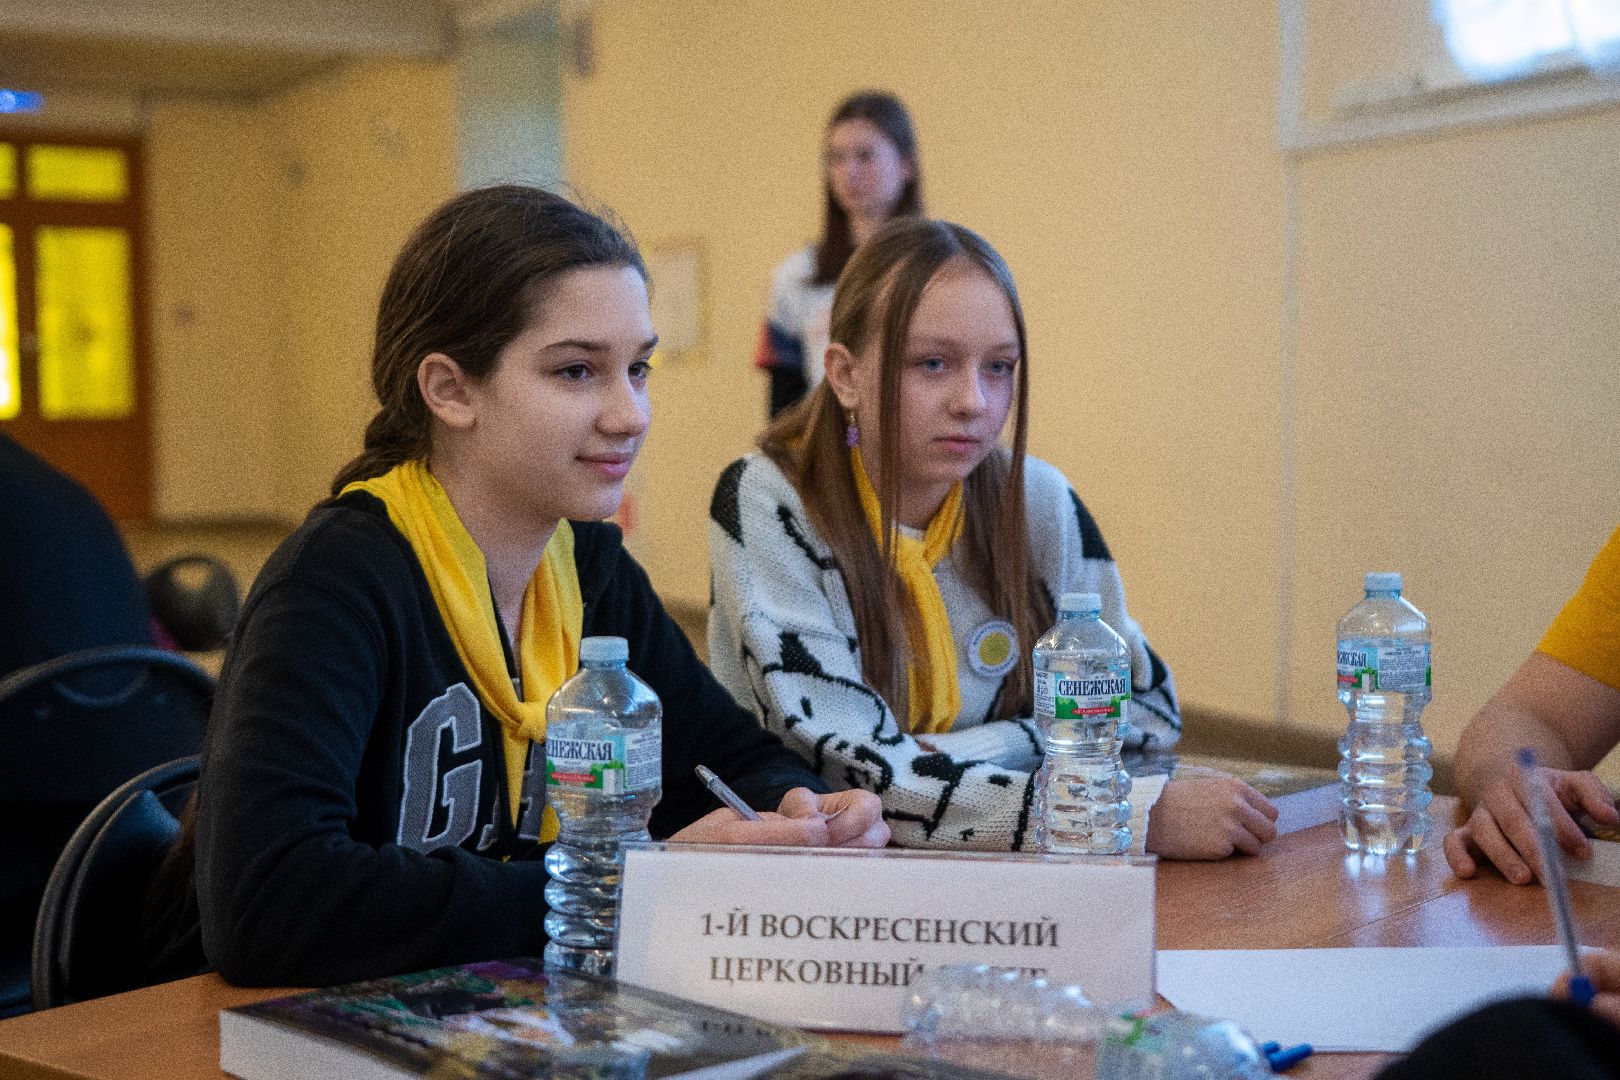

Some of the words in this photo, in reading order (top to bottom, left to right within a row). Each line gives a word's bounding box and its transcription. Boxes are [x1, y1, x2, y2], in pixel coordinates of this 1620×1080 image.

[1058, 678, 1126, 696] СЕНЕЖСКАЯ
[546, 739, 613, 761] ЕНЕЖСКАЯ
[701, 906, 750, 937] 1-Й
[760, 913, 1059, 947] ВОСКРЕСЕНСКИЙ
[709, 956, 925, 986] ЦЕРКОВНЫЙ
